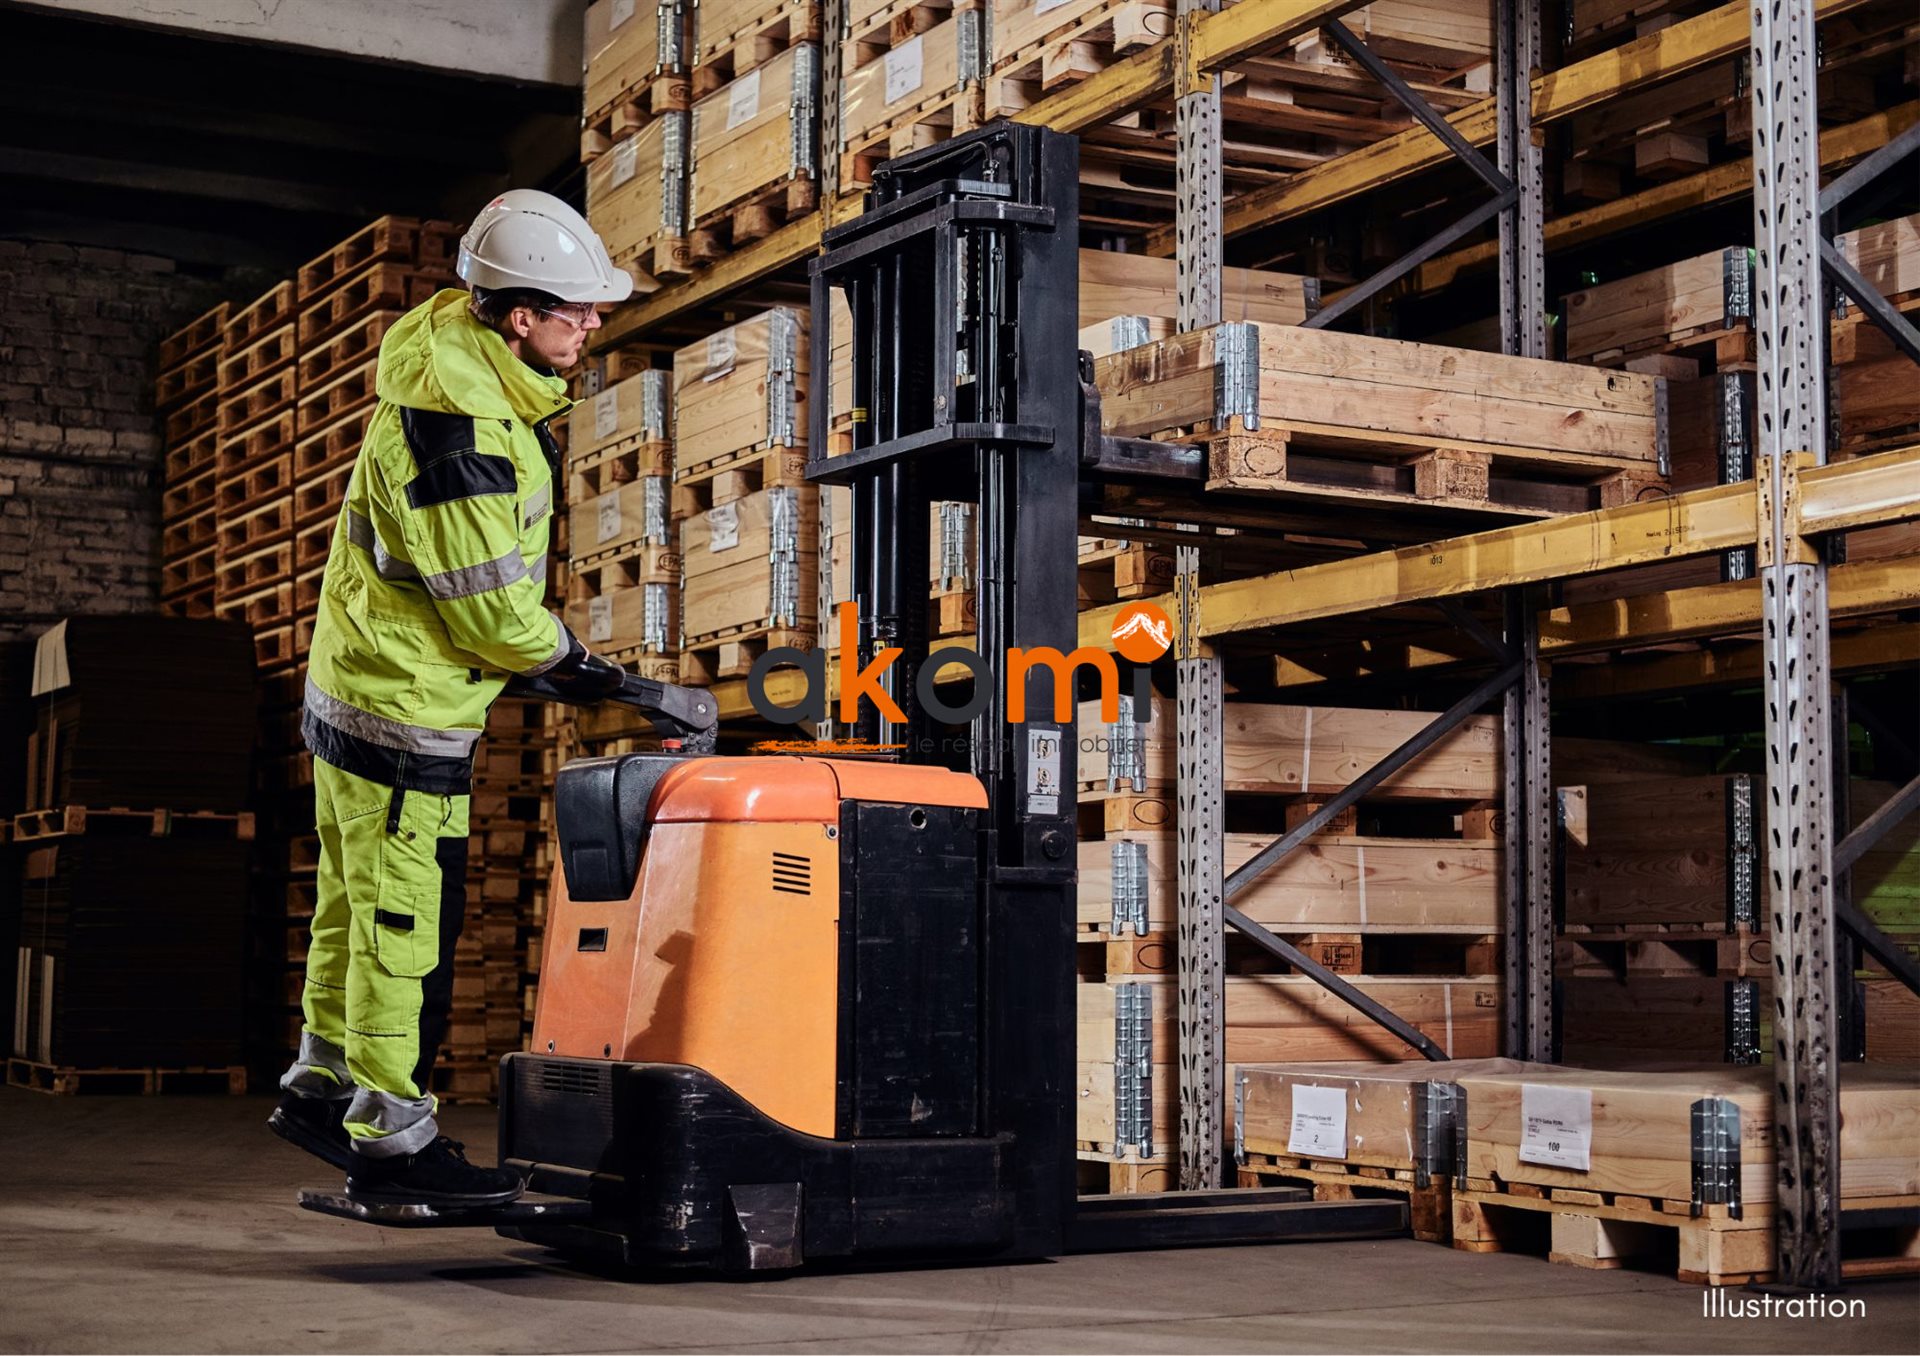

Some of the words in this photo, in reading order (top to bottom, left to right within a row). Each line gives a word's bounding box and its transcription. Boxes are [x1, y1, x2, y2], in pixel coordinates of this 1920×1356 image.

[662, 556, 678, 567] EPA
[1313, 1134, 1319, 1143] 2
[1548, 1141, 1560, 1152] 100
